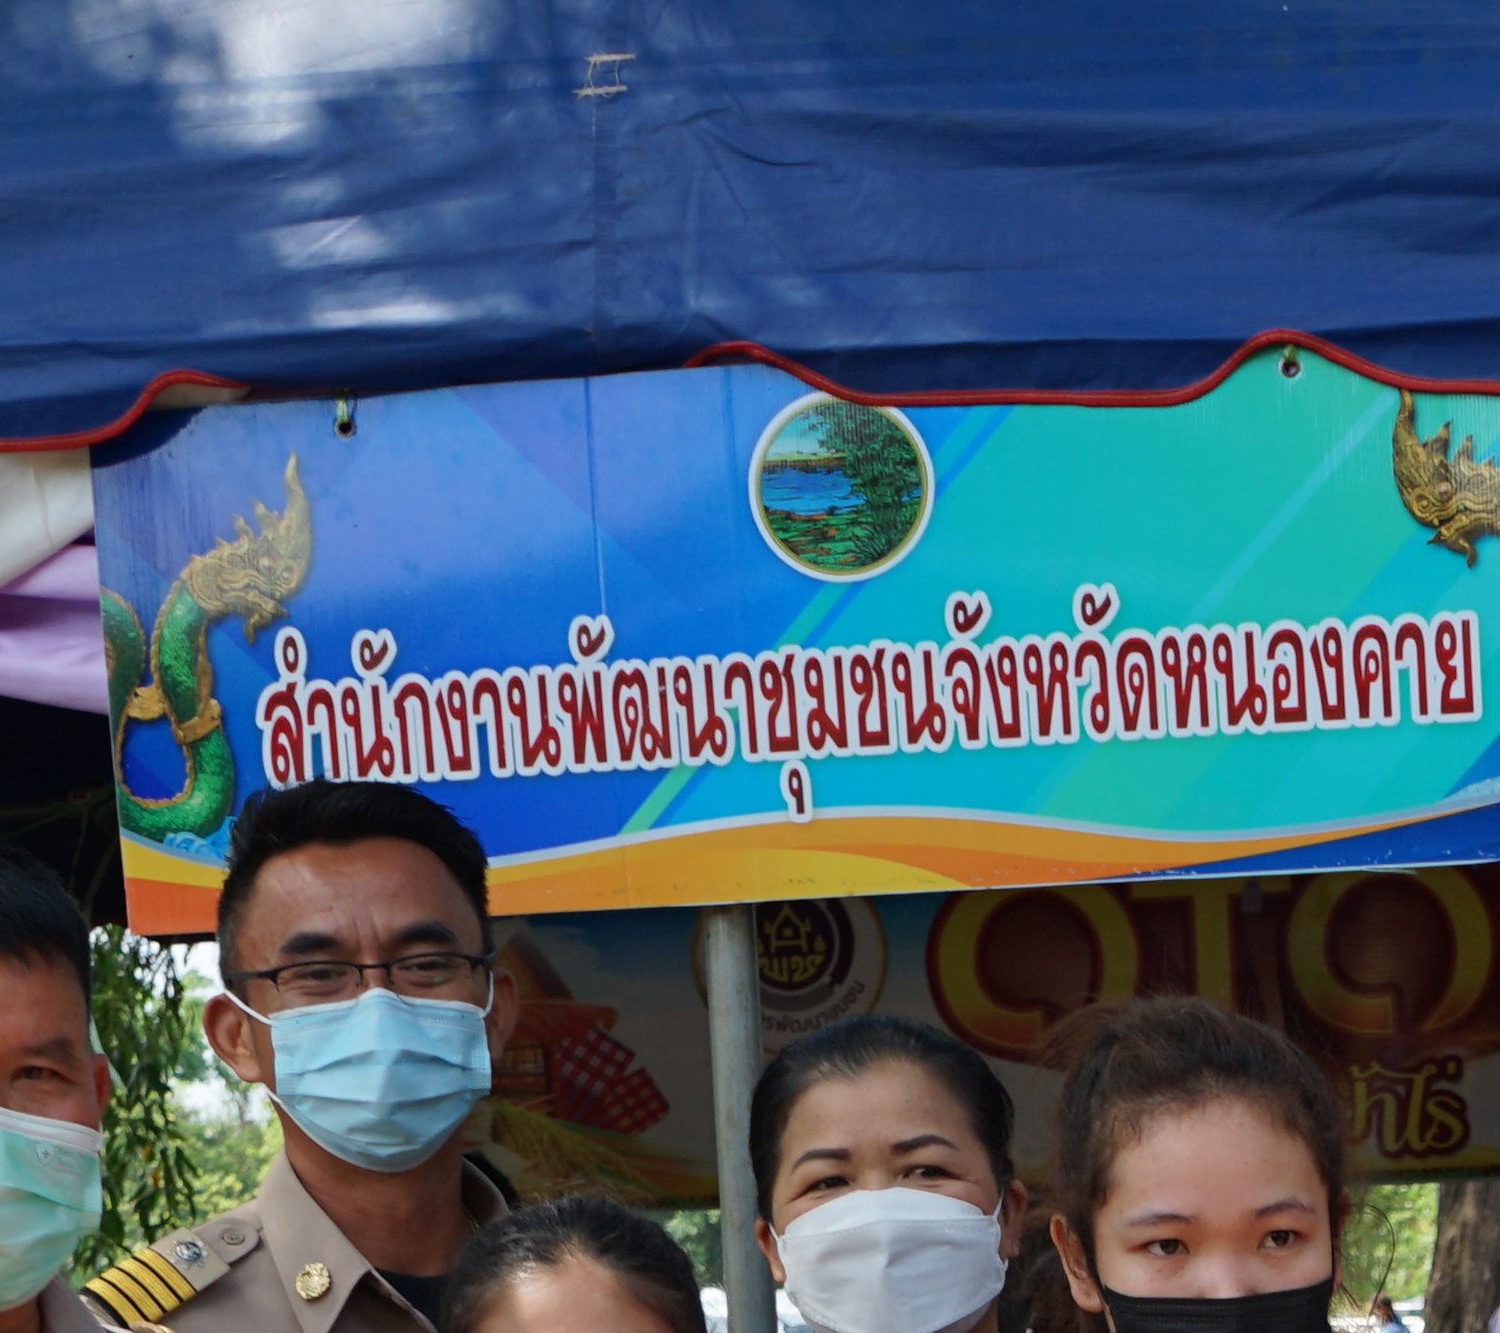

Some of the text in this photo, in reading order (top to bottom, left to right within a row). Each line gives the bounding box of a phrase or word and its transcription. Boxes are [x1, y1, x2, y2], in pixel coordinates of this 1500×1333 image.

[260, 586, 1476, 822] สำนักงานพัฒนาชุมชนจังหวัดหนองคาย
